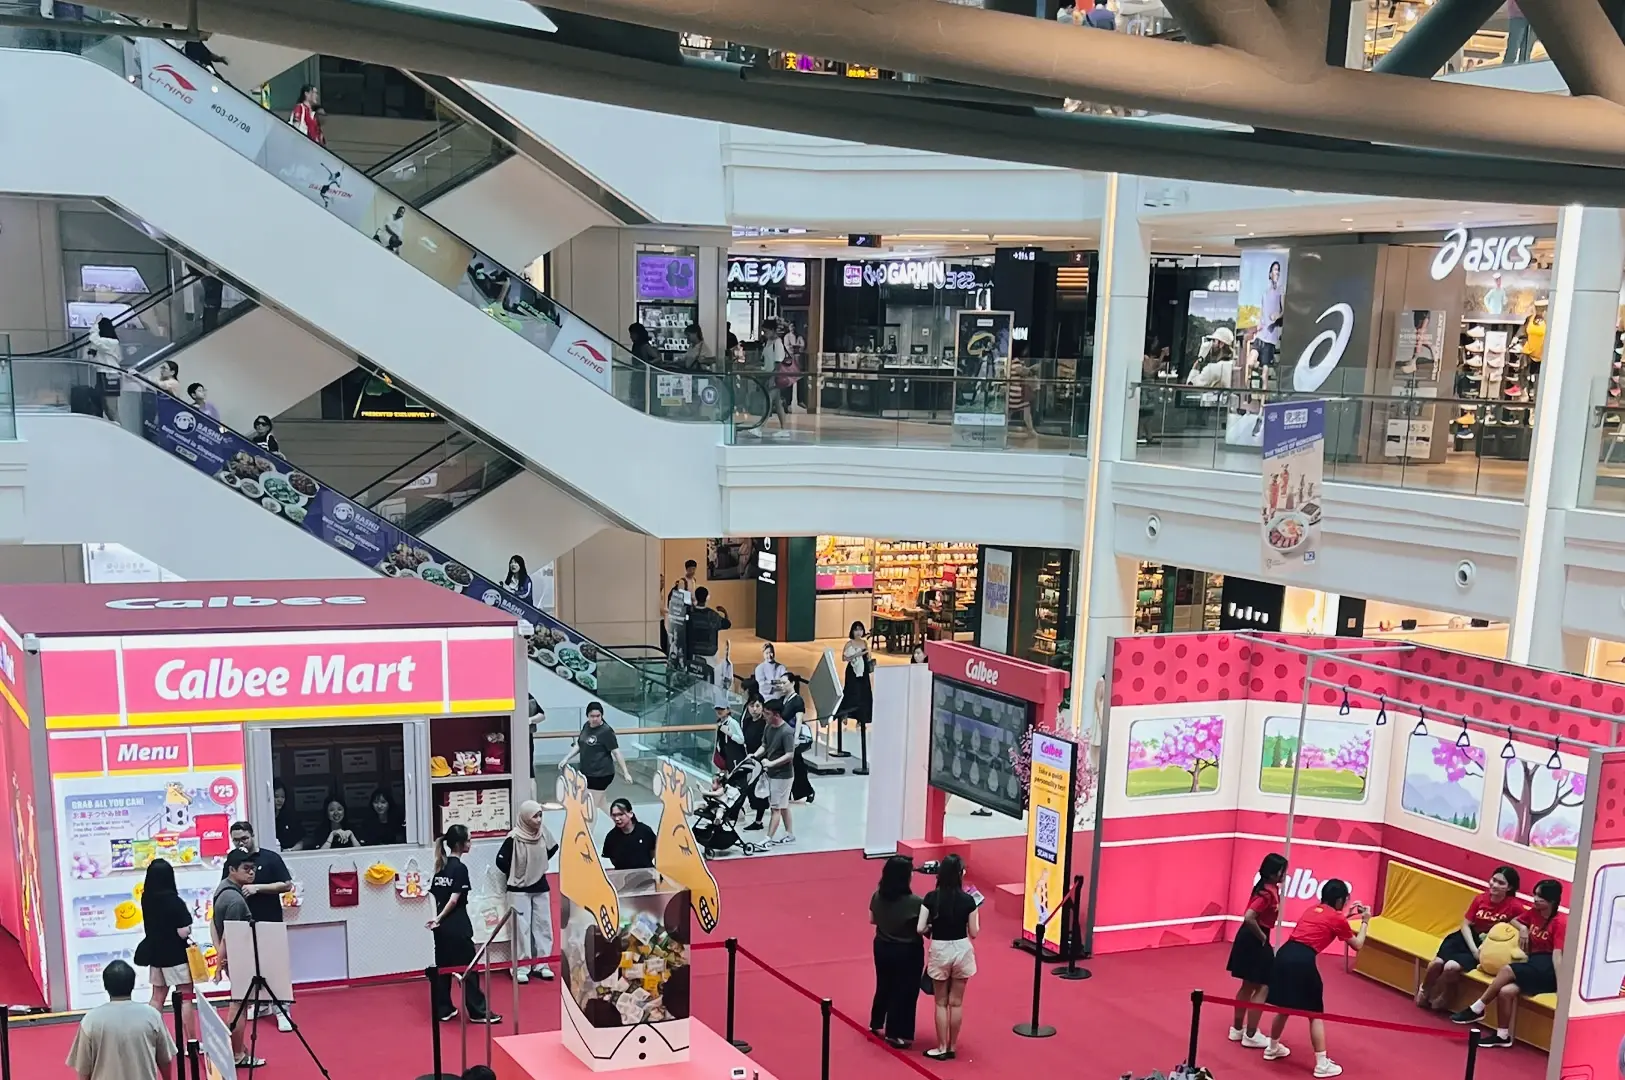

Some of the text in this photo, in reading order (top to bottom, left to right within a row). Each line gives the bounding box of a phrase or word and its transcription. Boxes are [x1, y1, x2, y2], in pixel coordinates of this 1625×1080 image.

[148, 72, 194, 104] LI-NING
[211, 104, 251, 133] #03-07/08
[888, 261, 944, 284] GARMIN
[567, 348, 604, 374] LI-NING
[197, 423, 224, 441] BASHU
[355, 513, 380, 531] BASHU
[105, 594, 366, 610] Calbee
[502, 599, 525, 616] BASHU
[154, 654, 417, 700] Calbee Mart
[965, 658, 999, 685] Calbee
[117, 742, 179, 762] Menu
[1040, 741, 1063, 758] Calbee
[214, 785, 233, 797] $25
[1034, 777, 1058, 790] personality
[94, 799, 107, 808] ALL
[108, 798, 124, 807] YOU
[1037, 849, 1048, 858] SCAN
